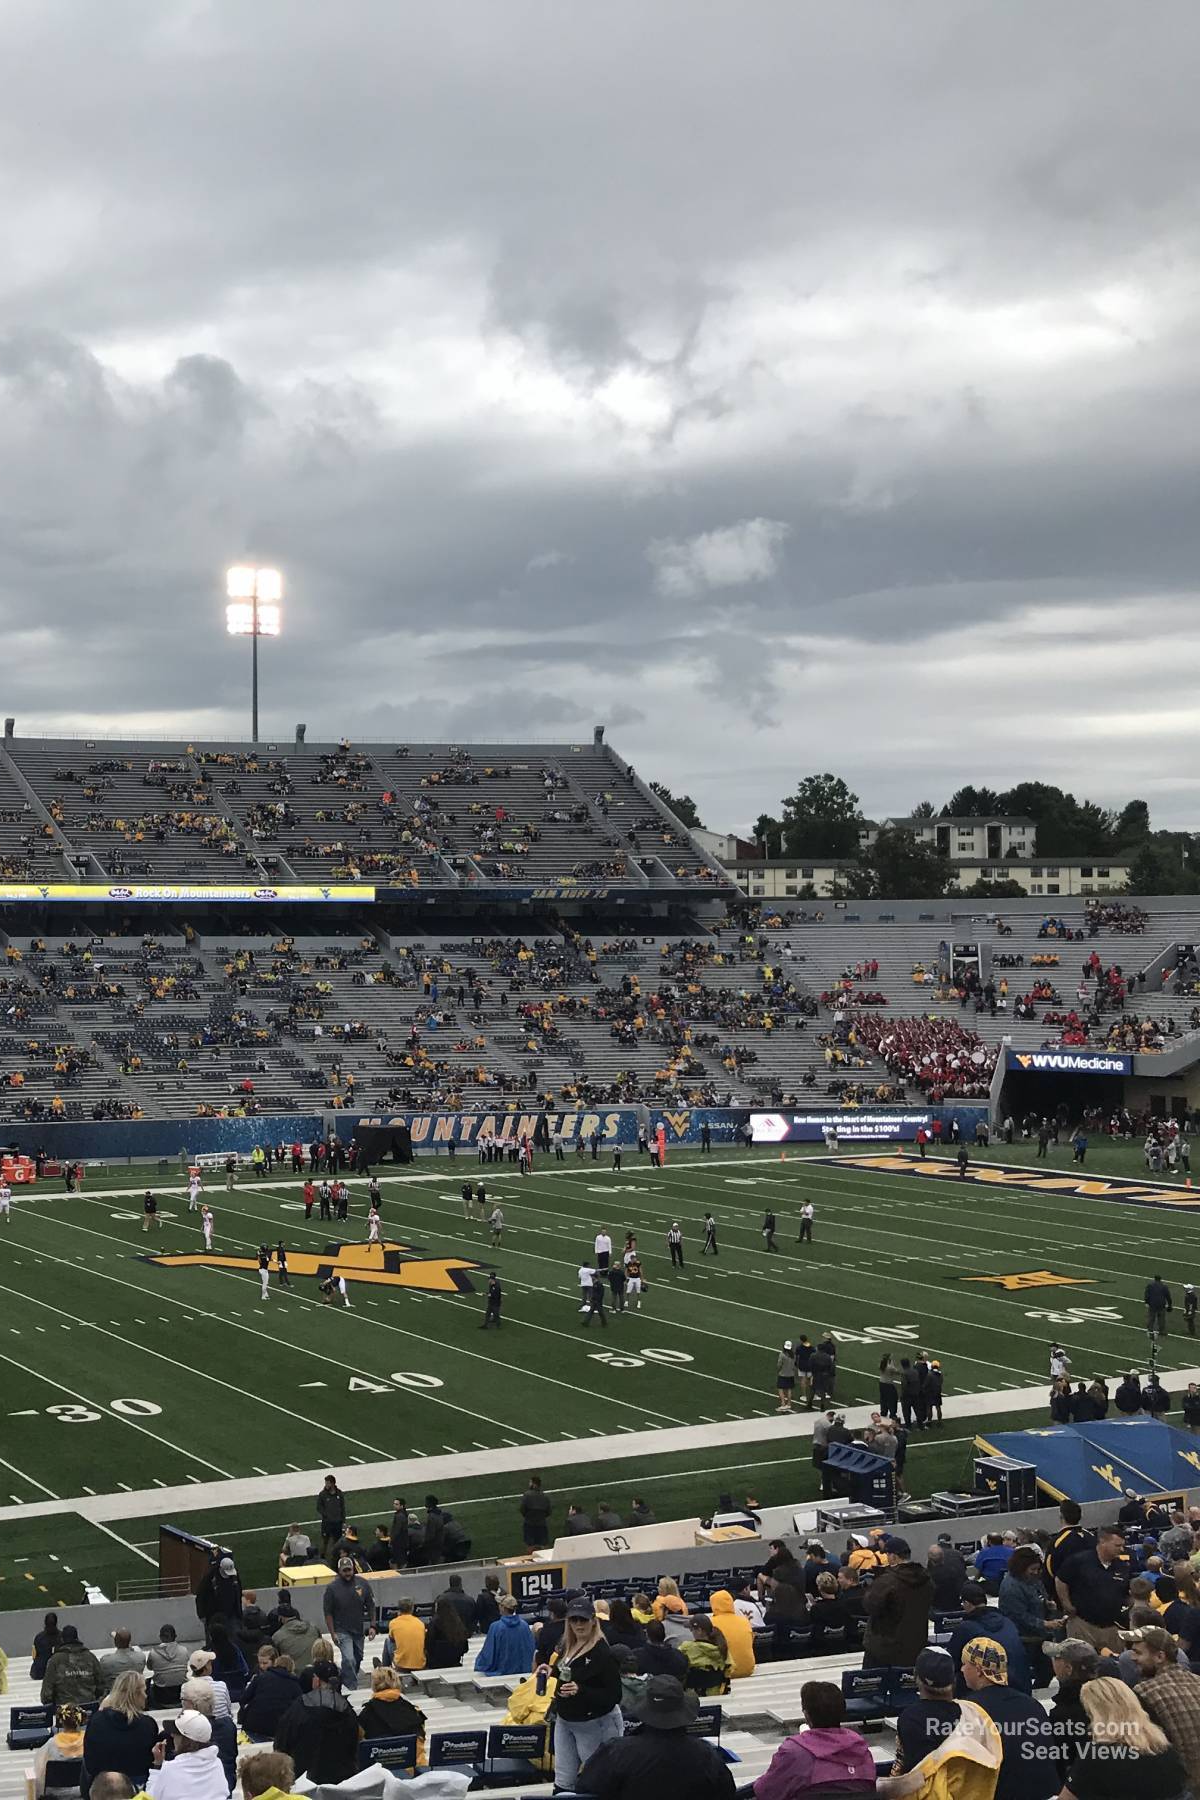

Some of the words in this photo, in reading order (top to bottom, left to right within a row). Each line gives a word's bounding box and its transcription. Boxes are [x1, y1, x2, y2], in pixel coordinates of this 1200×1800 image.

[135, 888, 161, 898] Rock
[163, 888, 178, 898] On
[180, 889, 250, 899] Mountaineers
[822, 1126, 852, 1134] Stating
[874, 1125, 899, 1133] $100's!
[903, 1115, 928, 1124] Country!
[1024, 1305, 1124, 1324] 30
[830, 1325, 920, 1345] 40
[586, 1348, 695, 1368] 50
[347, 1372, 444, 1394] 40
[46, 1398, 163, 1424] 30
[521, 1574, 553, 1597] 124
